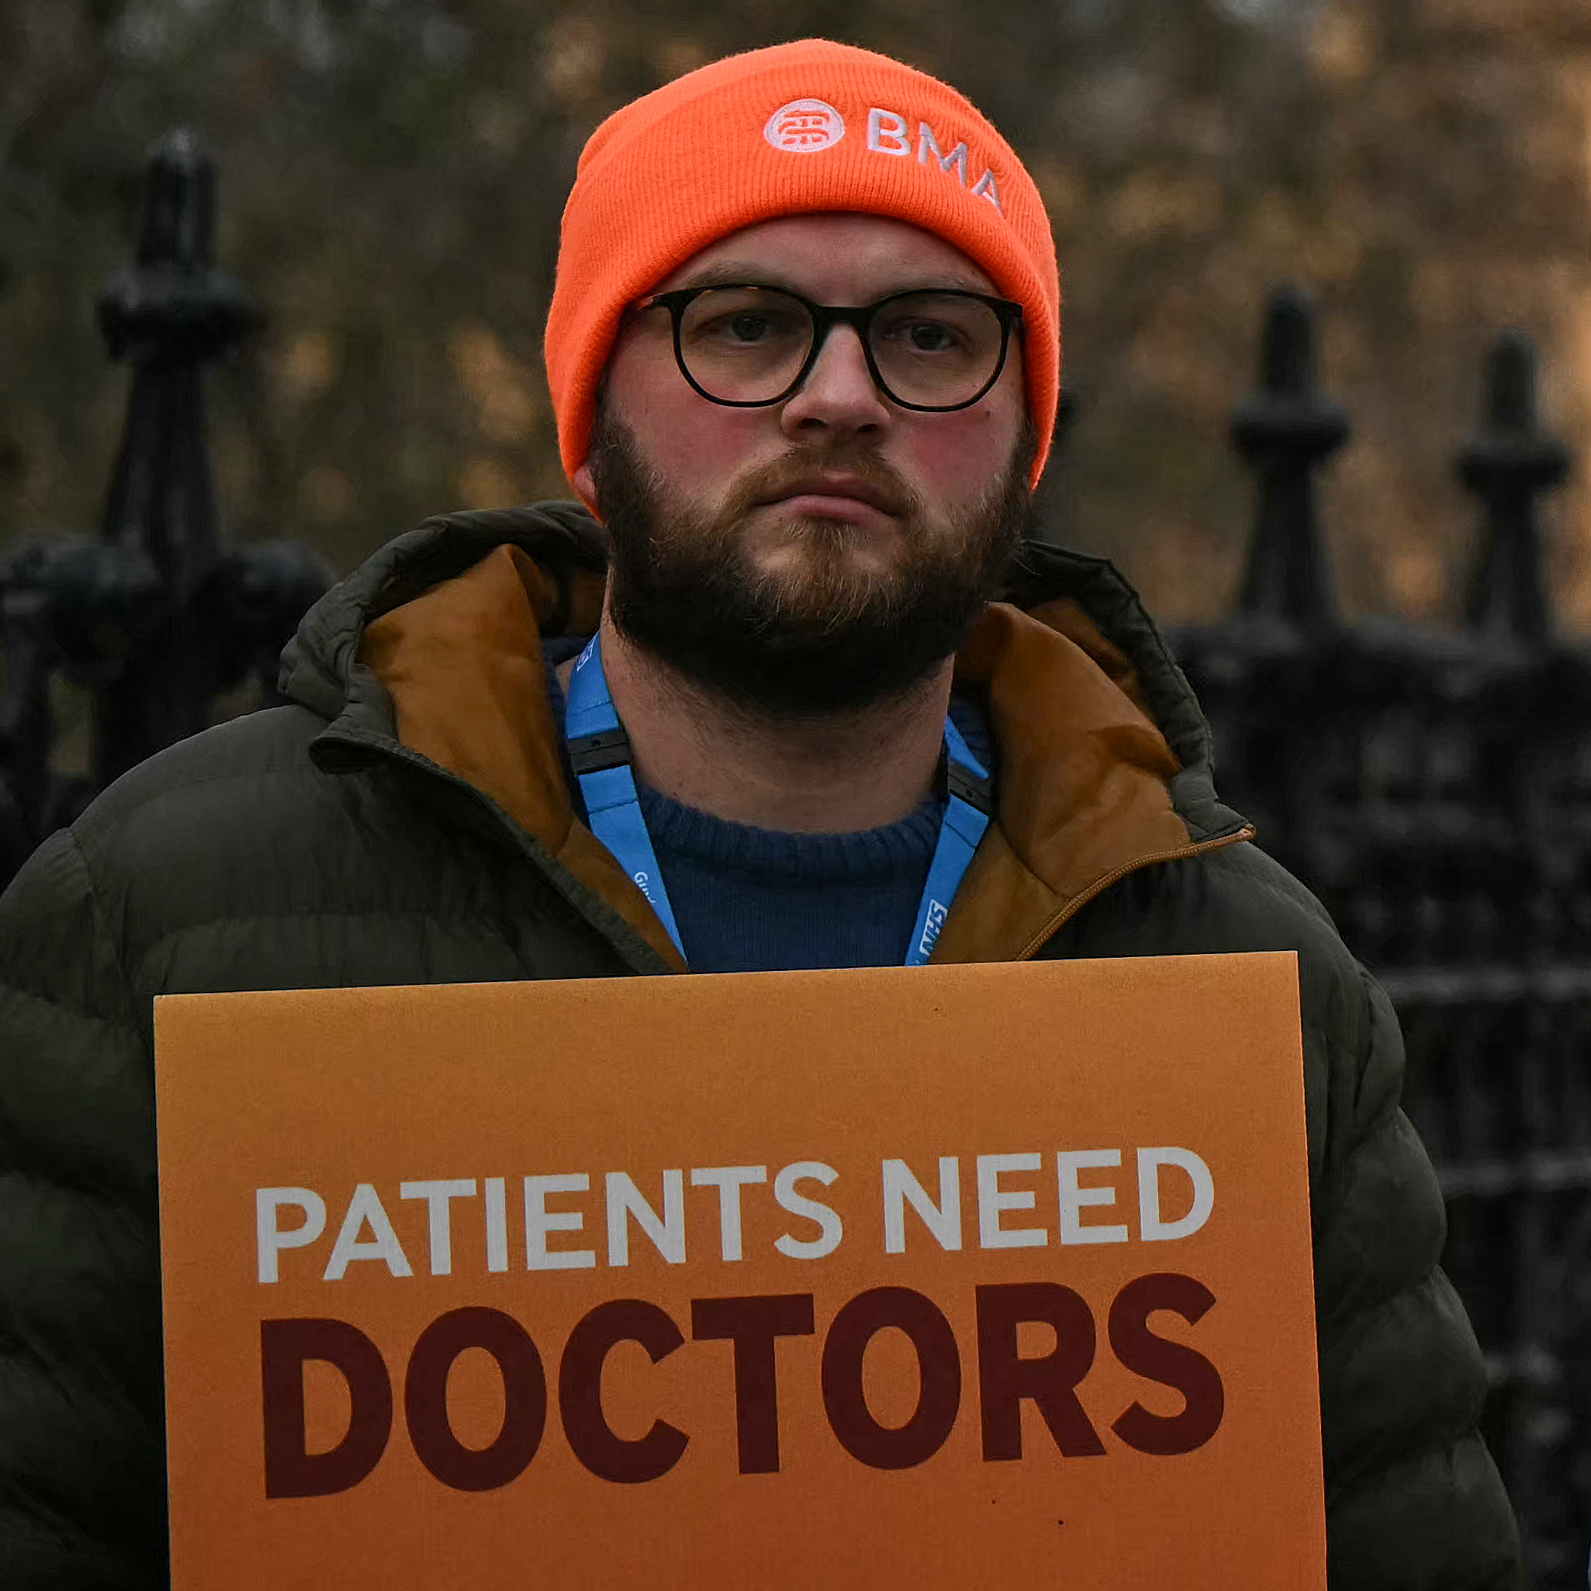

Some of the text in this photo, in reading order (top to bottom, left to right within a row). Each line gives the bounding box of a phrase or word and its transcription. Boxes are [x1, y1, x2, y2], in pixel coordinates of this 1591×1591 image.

[867, 107, 1004, 215] BMA
[921, 900, 947, 954] NHS
[256, 1147, 1214, 1283] PATIENTS NEED
[261, 1273, 1224, 1499] DOCTORS
